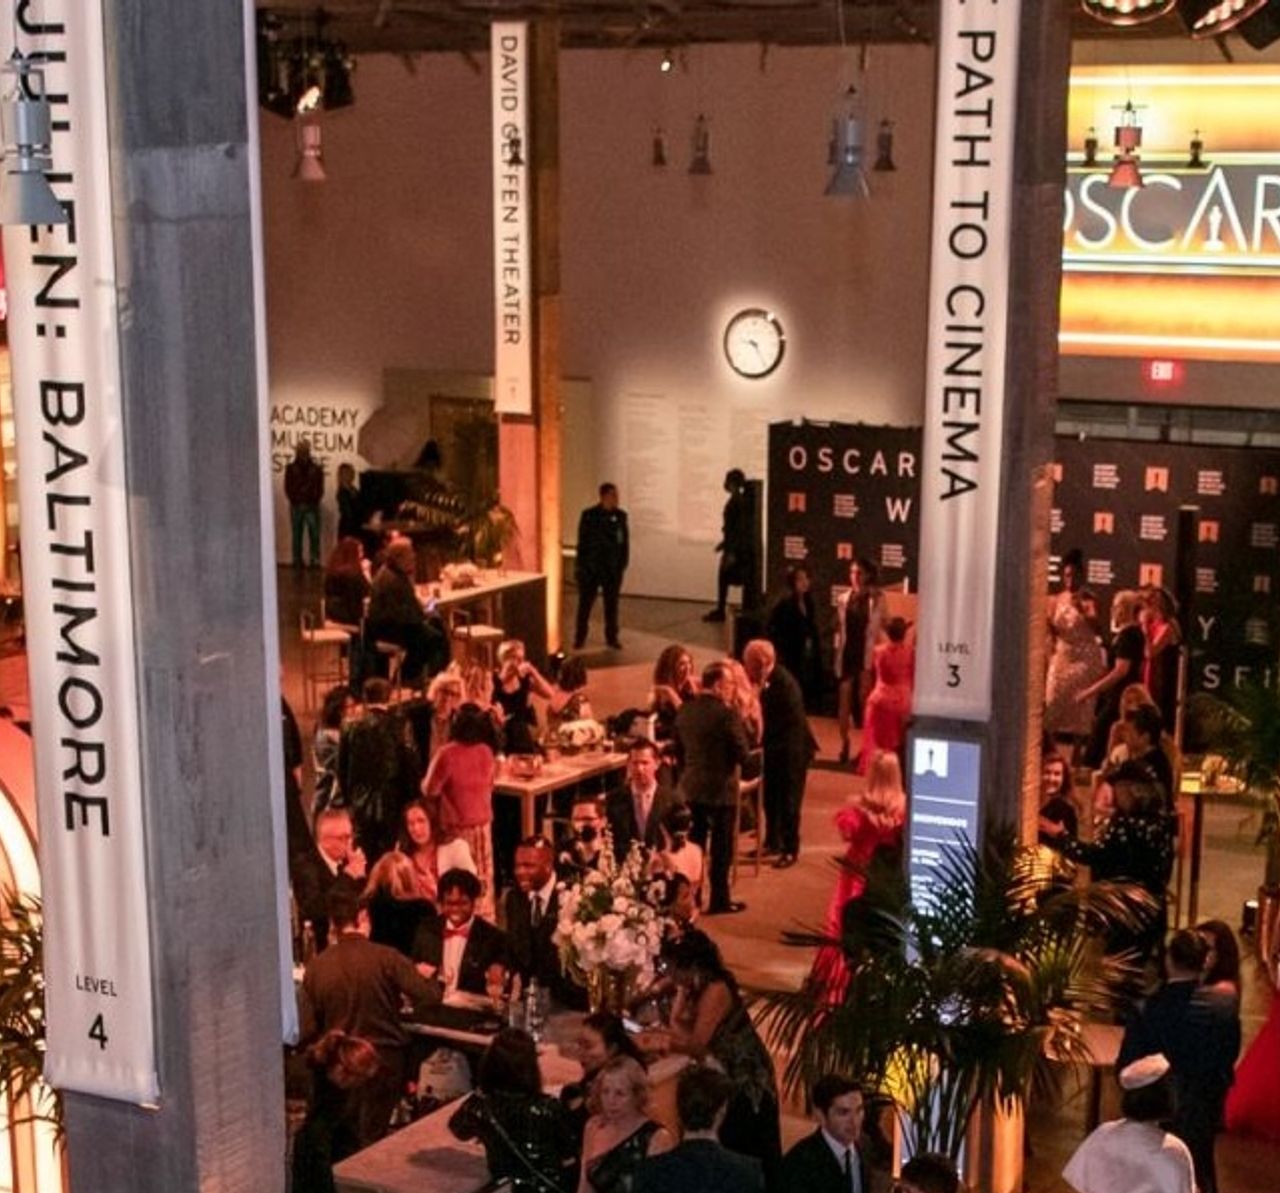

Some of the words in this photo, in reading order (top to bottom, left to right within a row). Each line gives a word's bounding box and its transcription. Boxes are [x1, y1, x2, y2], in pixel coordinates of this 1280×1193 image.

[500, 35, 518, 112] DAVID
[952, 31, 997, 167] PATH
[948, 191, 990, 260] TO
[502, 234, 522, 345] THEATER
[270, 404, 359, 428] ACADEMY
[939, 284, 986, 501] CINEMA
[271, 430, 355, 452] MUSEUM
[39, 379, 110, 837] BALTIMORE
[938, 641, 971, 656] LEVEL
[946, 663, 962, 688] 3
[76, 973, 118, 997] LEVEL
[88, 1011, 109, 1051] 4
